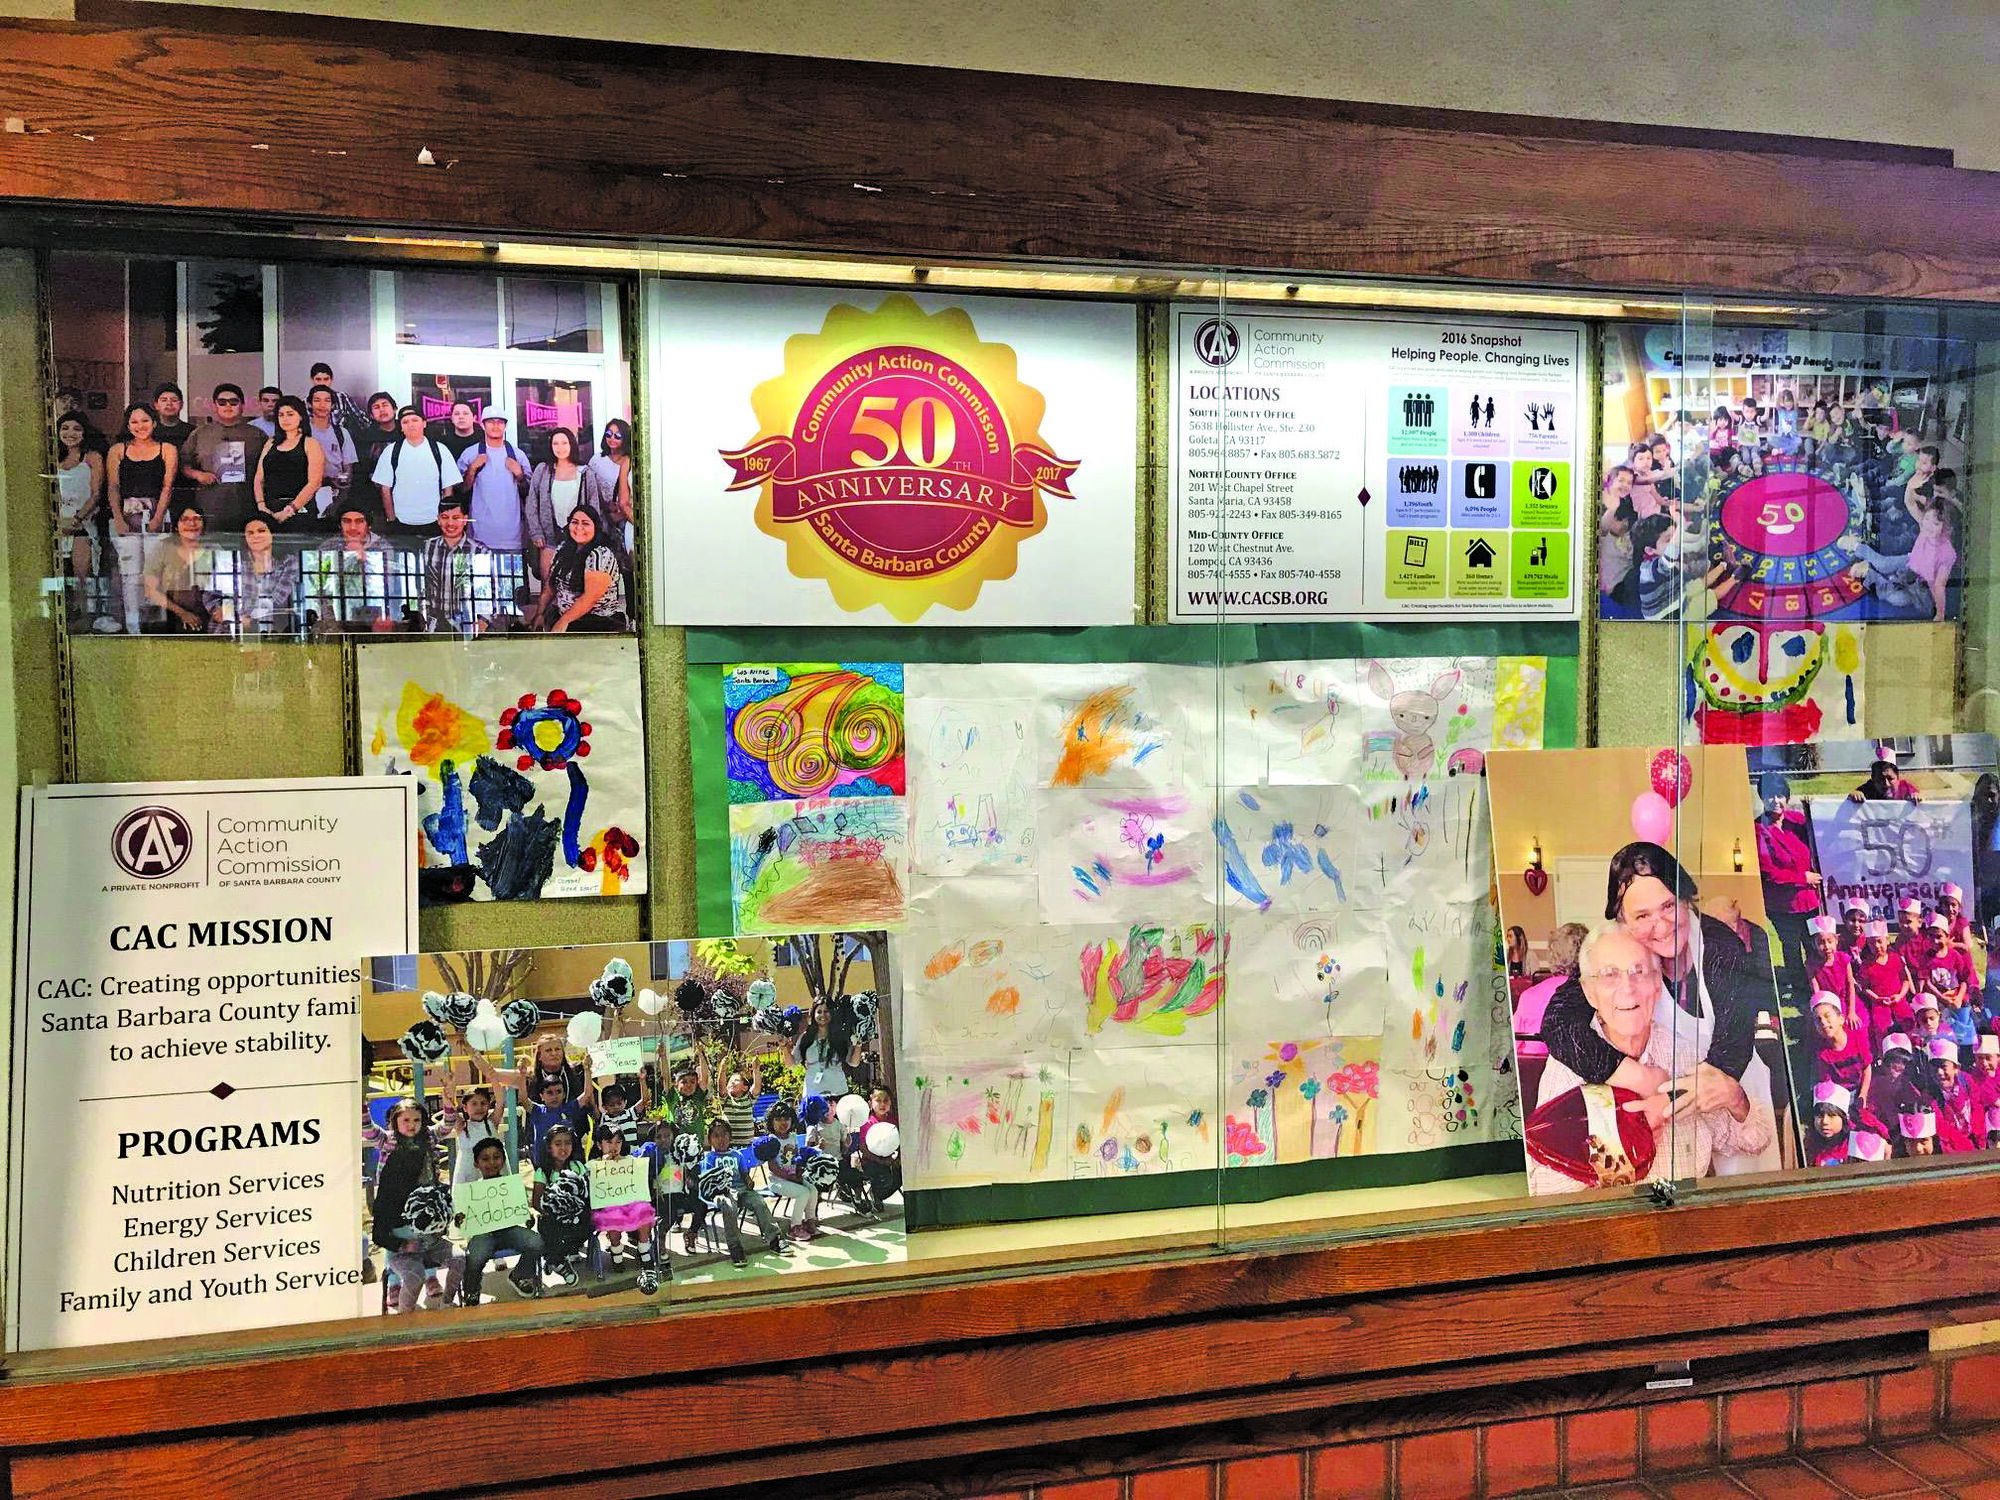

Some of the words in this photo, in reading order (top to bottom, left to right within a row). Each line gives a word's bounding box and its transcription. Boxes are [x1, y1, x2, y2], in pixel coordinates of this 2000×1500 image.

[1254, 329, 1324, 345] Community
[1442, 332, 1467, 344] 2016
[1471, 334, 1522, 347] Snapshot
[1254, 344, 1294, 355] Action
[1391, 348, 1435, 362] Helping
[1440, 350, 1481, 364] People.
[1485, 352, 1540, 367] Changing
[1544, 355, 1569, 366] Lives
[1254, 357, 1325, 369] Commission
[801, 361, 874, 443] Community
[877, 354, 934, 374] Action
[1190, 386, 1280, 401] LOCATIONS
[1225, 409, 1260, 419] COUNTY
[1264, 410, 1296, 419] OFFICE
[849, 396, 956, 468] 50
[1189, 421, 1212, 431] 5638
[1215, 423, 1254, 432] Hollister
[1299, 424, 1315, 432] 230
[1238, 436, 1265, 445] 93117
[1260, 450, 1277, 458] Fax
[1279, 450, 1340, 460] 805.683.5872
[743, 457, 772, 473] 1967
[953, 461, 971, 471] TH
[1036, 466, 1062, 482] 2017
[1189, 469, 1222, 479] NORTH
[1224, 470, 1262, 479] COUNTY
[1265, 471, 1297, 479] OFFICE
[798, 476, 1018, 512] ANNIVERSARY
[1189, 483, 1205, 492] 201
[1208, 483, 1231, 492] West
[1234, 483, 1264, 493] Chapel
[1267, 484, 1294, 493] Street
[1188, 497, 1214, 505] Santa
[1248, 497, 1260, 506] CA
[1263, 497, 1292, 506] 93458
[1261, 511, 1277, 519] Fax
[1279, 511, 1342, 519] 805-349-8165
[1756, 502, 1805, 526] 50
[814, 512, 858, 559] Santa
[859, 550, 933, 573] Barbara
[935, 515, 992, 567] County
[1188, 530, 1249, 539] MID-COUNTY
[1251, 531, 1284, 539] OFFICE
[1189, 544, 1205, 553] 120
[1208, 544, 1230, 553] West
[1233, 545, 1273, 553] Chestnut
[1276, 545, 1294, 553] Ave.
[1229, 558, 1241, 566] CA
[1244, 557, 1273, 566] 93436
[1260, 570, 1276, 579] Fax
[1279, 570, 1341, 579] 805-740-4558
[1188, 591, 1327, 605] WWW.CACSB.ORG
[217, 815, 338, 836] Community
[217, 837, 288, 853] Action
[1860, 818, 1932, 878] 50
[217, 855, 340, 875] Commission
[111, 884, 143, 892] PRIVATE
[145, 881, 200, 891] NONPROFIT
[232, 879, 262, 887] SANTA
[264, 877, 304, 886] BARBARA
[306, 876, 341, 884] COUNTY
[110, 923, 177, 951] CAC
[188, 917, 333, 947] MISSION
[38, 978, 93, 1000] CAC:
[100, 974, 200, 999] Creating
[208, 966, 361, 995] opportunities
[41, 1011, 109, 1032] Santa
[117, 1006, 212, 1029] Barbara
[219, 1003, 299, 1029] County
[110, 1042, 134, 1061] to
[141, 1036, 227, 1060] achieve
[236, 1032, 332, 1057] stability.
[118, 1118, 321, 1159] PROGRAMS
[595, 1159, 633, 1177] Head
[112, 1180, 220, 1205] Nutrition
[228, 1171, 324, 1197] Services
[469, 1182, 509, 1201] Los
[595, 1181, 636, 1199] Start
[124, 1214, 208, 1239] Energy
[216, 1205, 313, 1230] Services
[464, 1199, 528, 1230] Adobes
[114, 1248, 217, 1273] Children
[224, 1238, 321, 1264] Services
[60, 1286, 140, 1313] Family
[148, 1283, 192, 1306] and
[201, 1276, 267, 1301] Youth
[275, 1267, 363, 1292] Service
